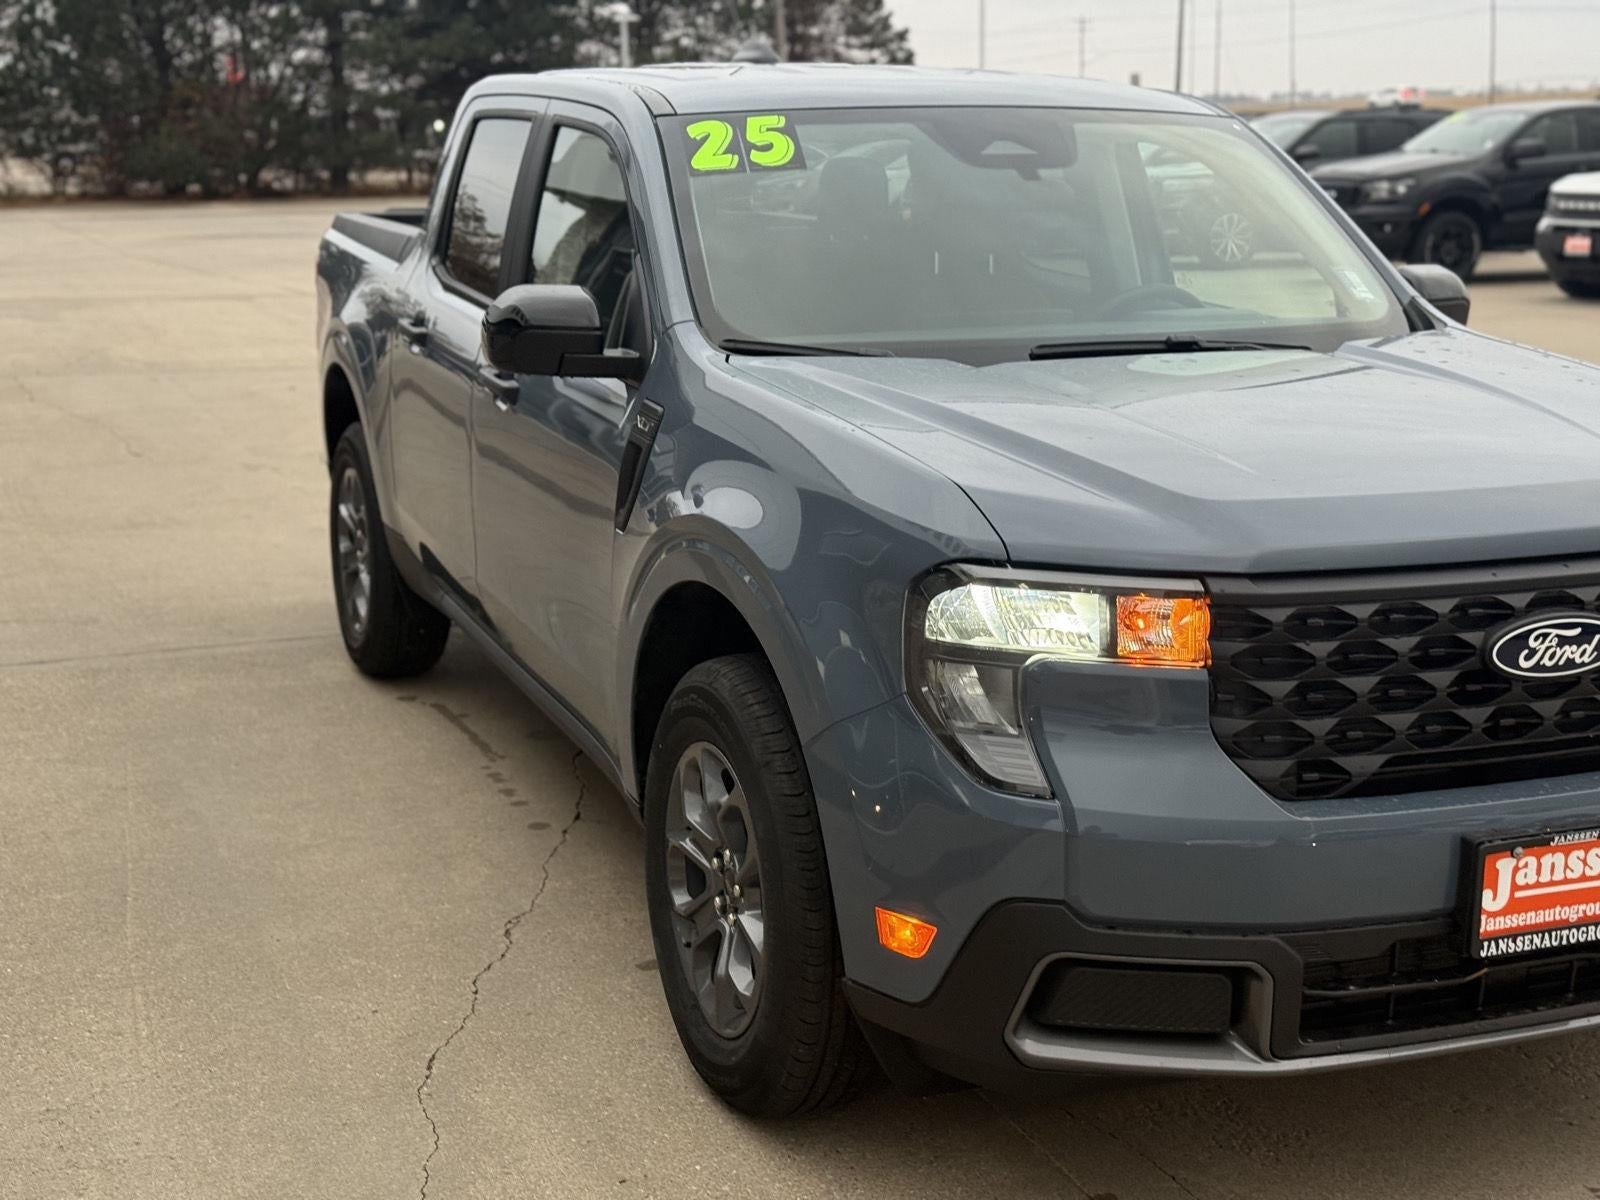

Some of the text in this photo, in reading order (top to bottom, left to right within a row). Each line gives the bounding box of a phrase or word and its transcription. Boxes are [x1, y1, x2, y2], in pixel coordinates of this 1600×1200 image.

[686, 114, 795, 171] 25
[1518, 627, 1600, 669] Ford
[1550, 830, 1600, 846] JANSSEN
[1481, 847, 1600, 912] Janss
